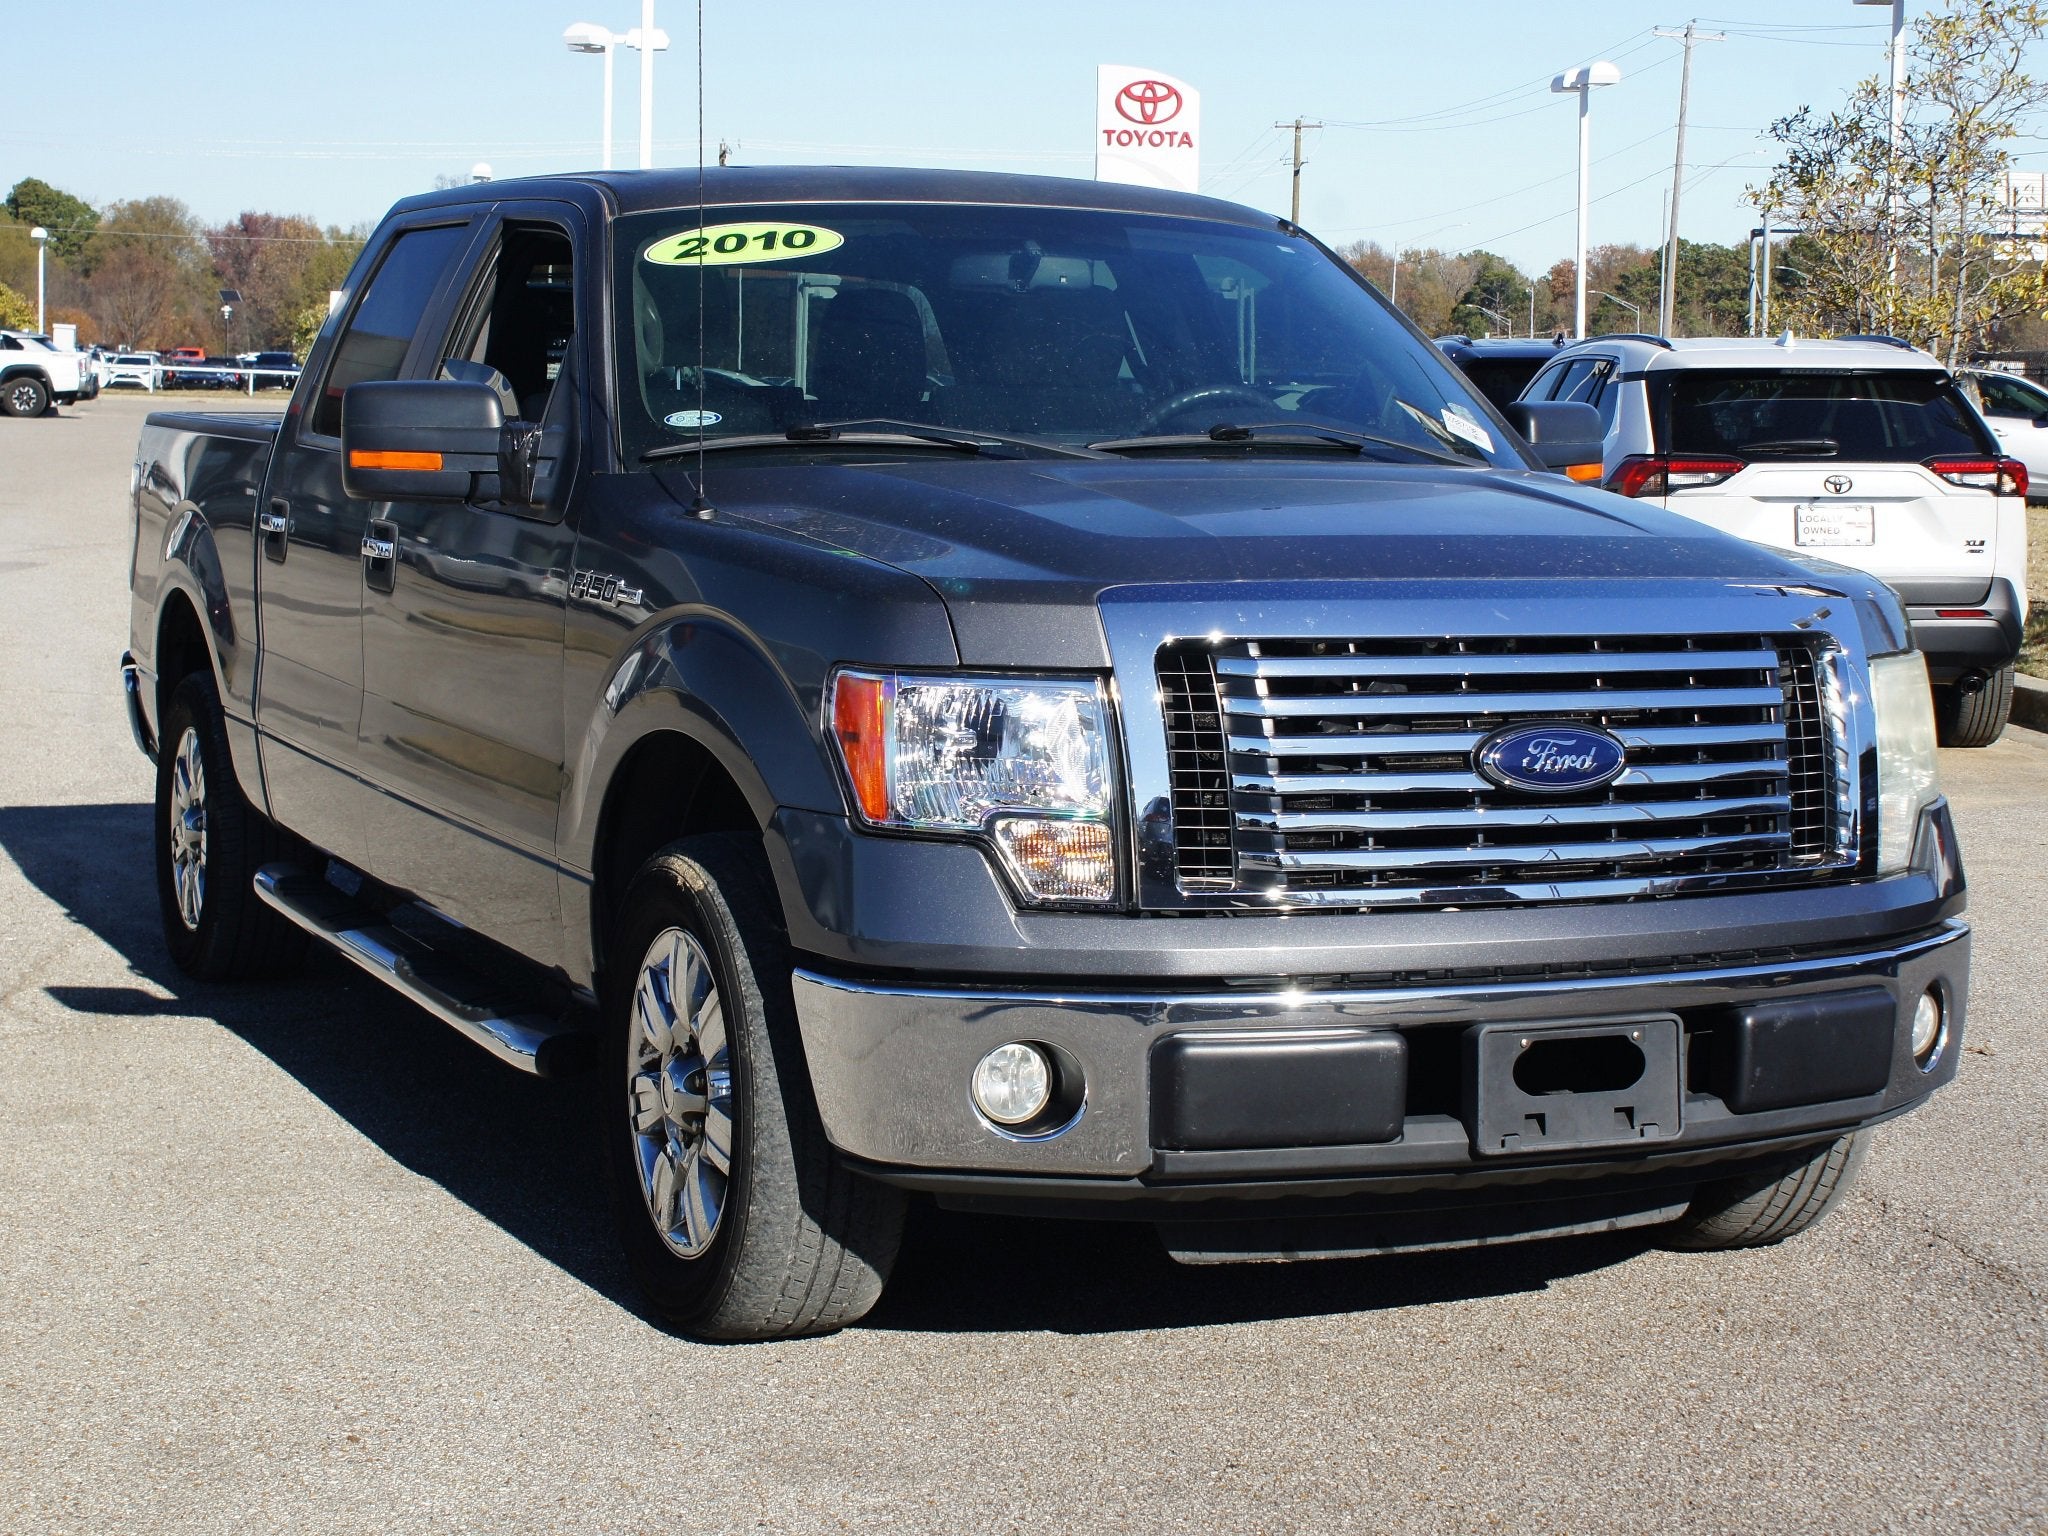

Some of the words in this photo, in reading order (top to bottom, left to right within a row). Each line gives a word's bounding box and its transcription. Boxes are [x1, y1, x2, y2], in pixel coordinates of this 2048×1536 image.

[1103, 130, 1193, 148] TOYOTA
[673, 229, 816, 260] 2010
[1803, 526, 1841, 535] OWNED
[1522, 737, 1599, 774] Ford
